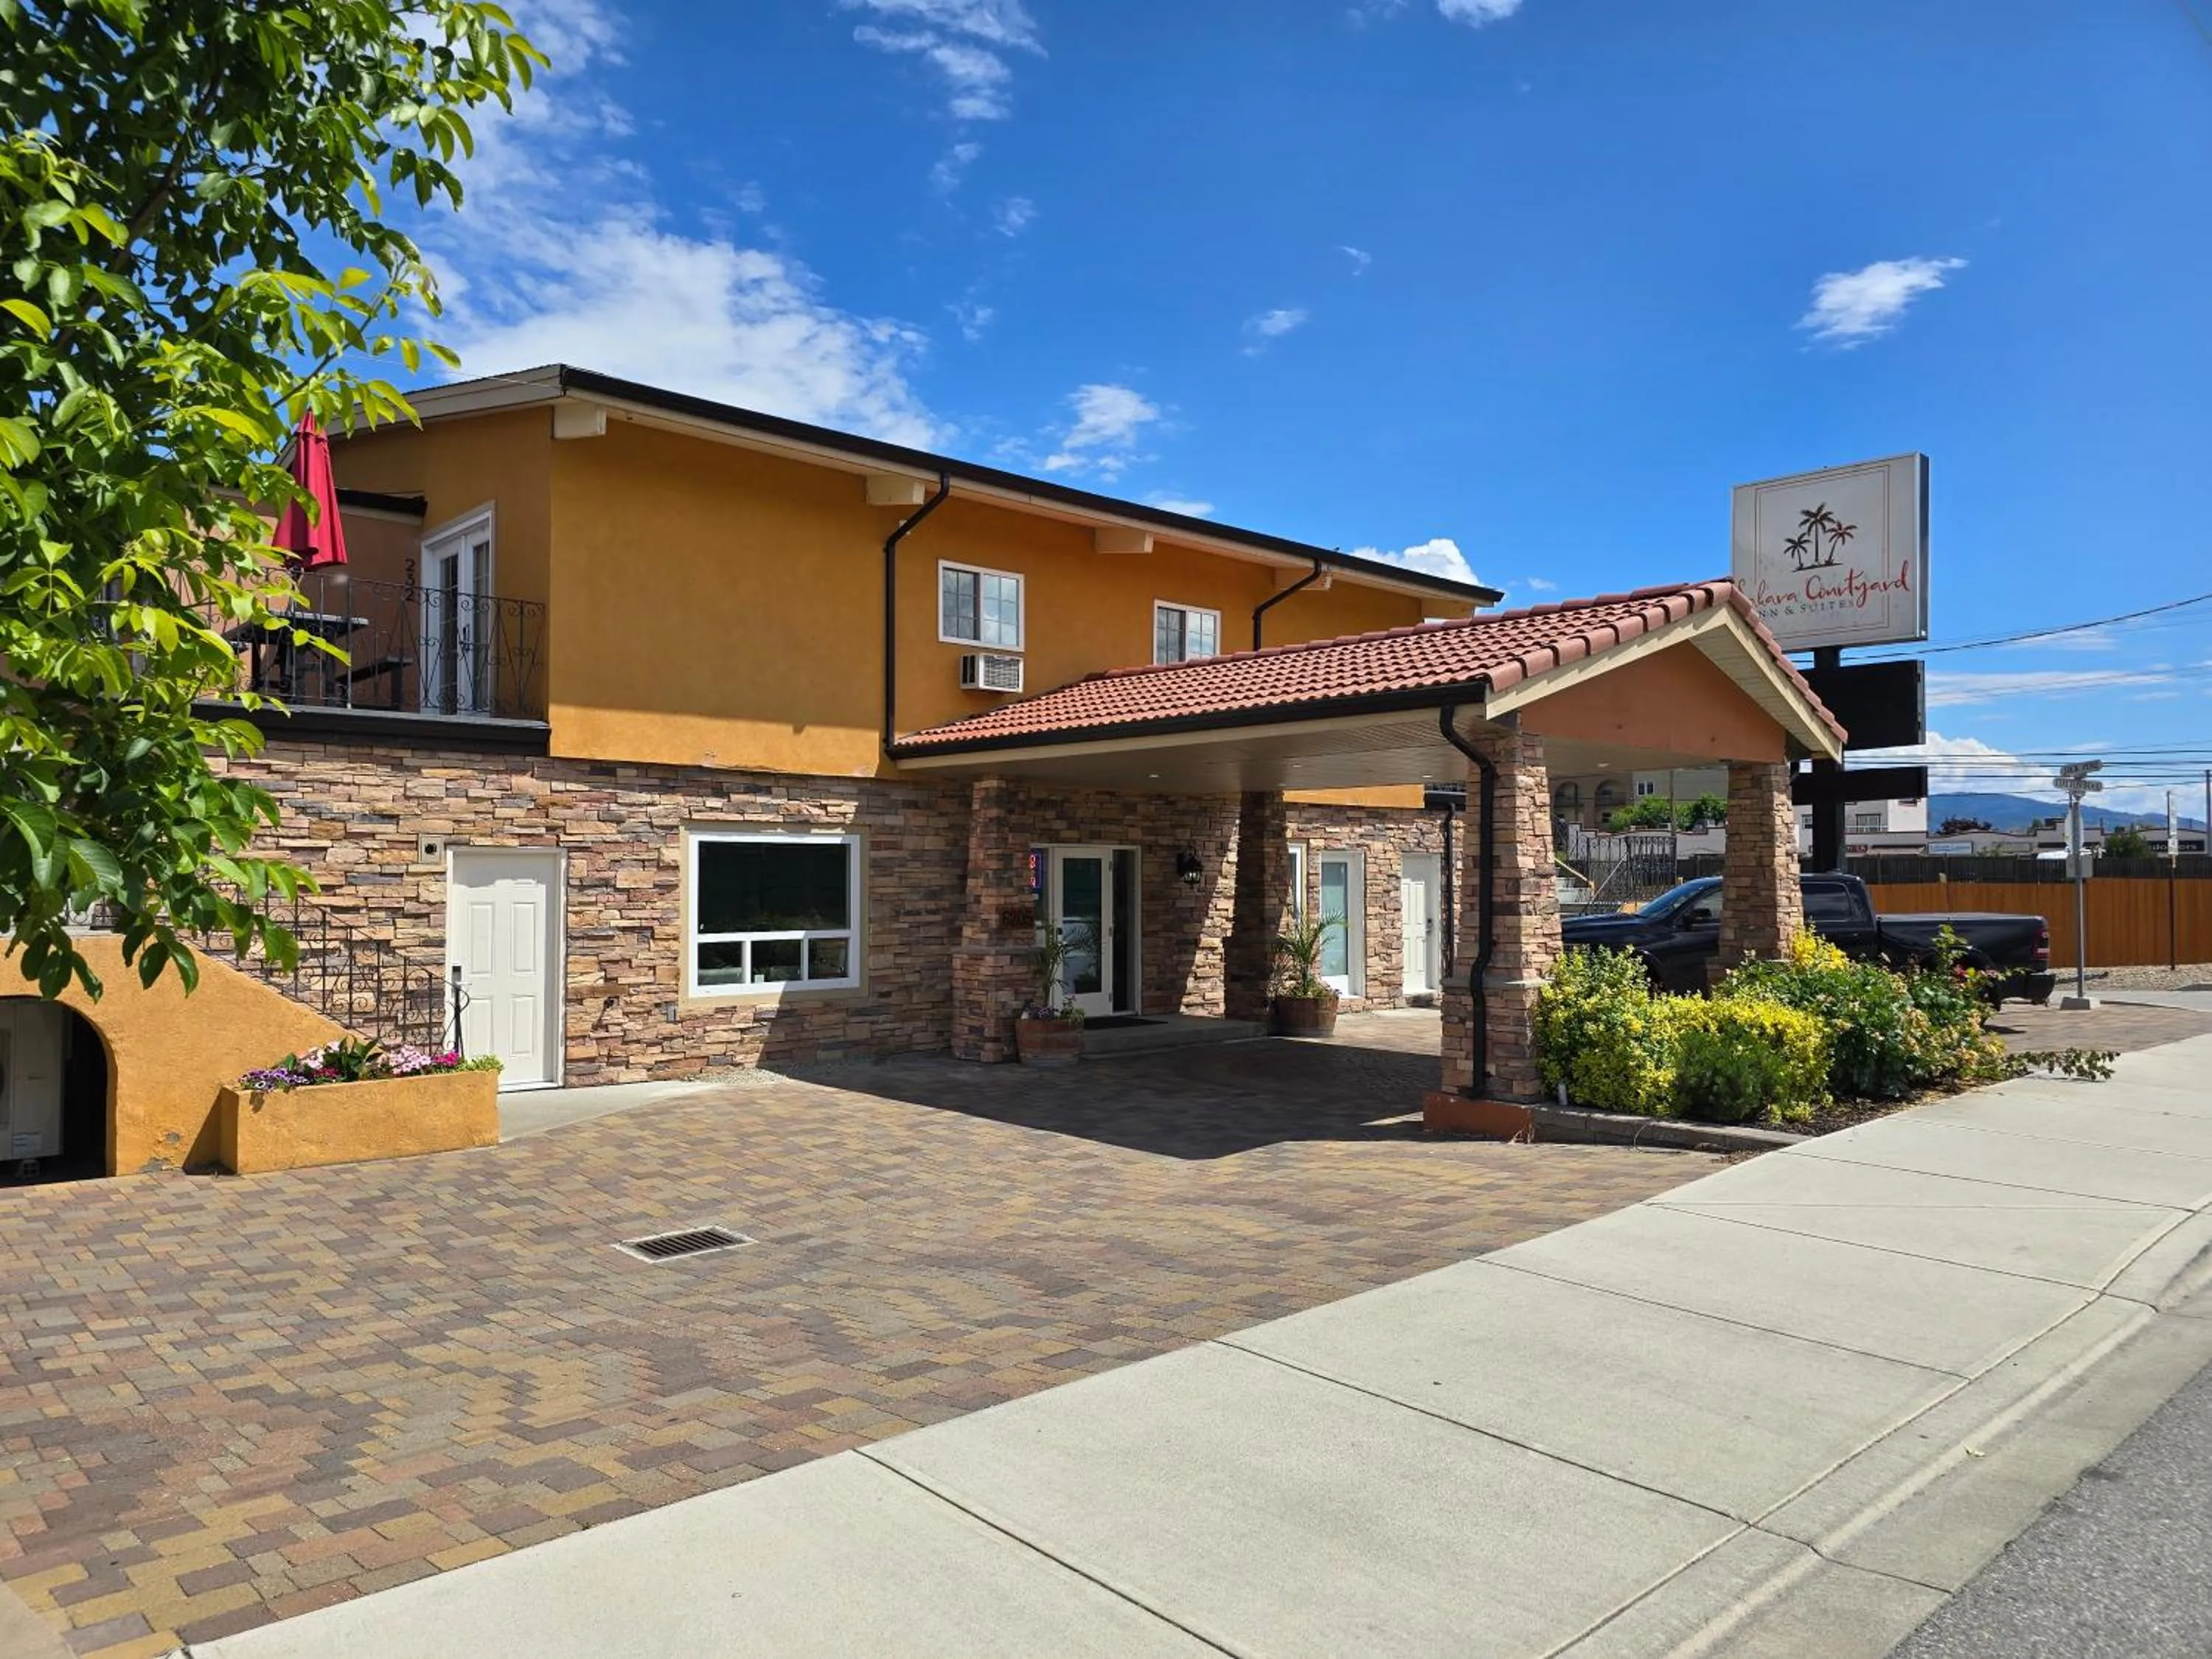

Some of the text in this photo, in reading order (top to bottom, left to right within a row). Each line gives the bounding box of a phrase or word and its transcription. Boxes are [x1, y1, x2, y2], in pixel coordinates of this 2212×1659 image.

[1806, 560, 1910, 608] Courtyard
[1784, 605, 1794, 615] &
[1799, 599, 1854, 613] SUITES
